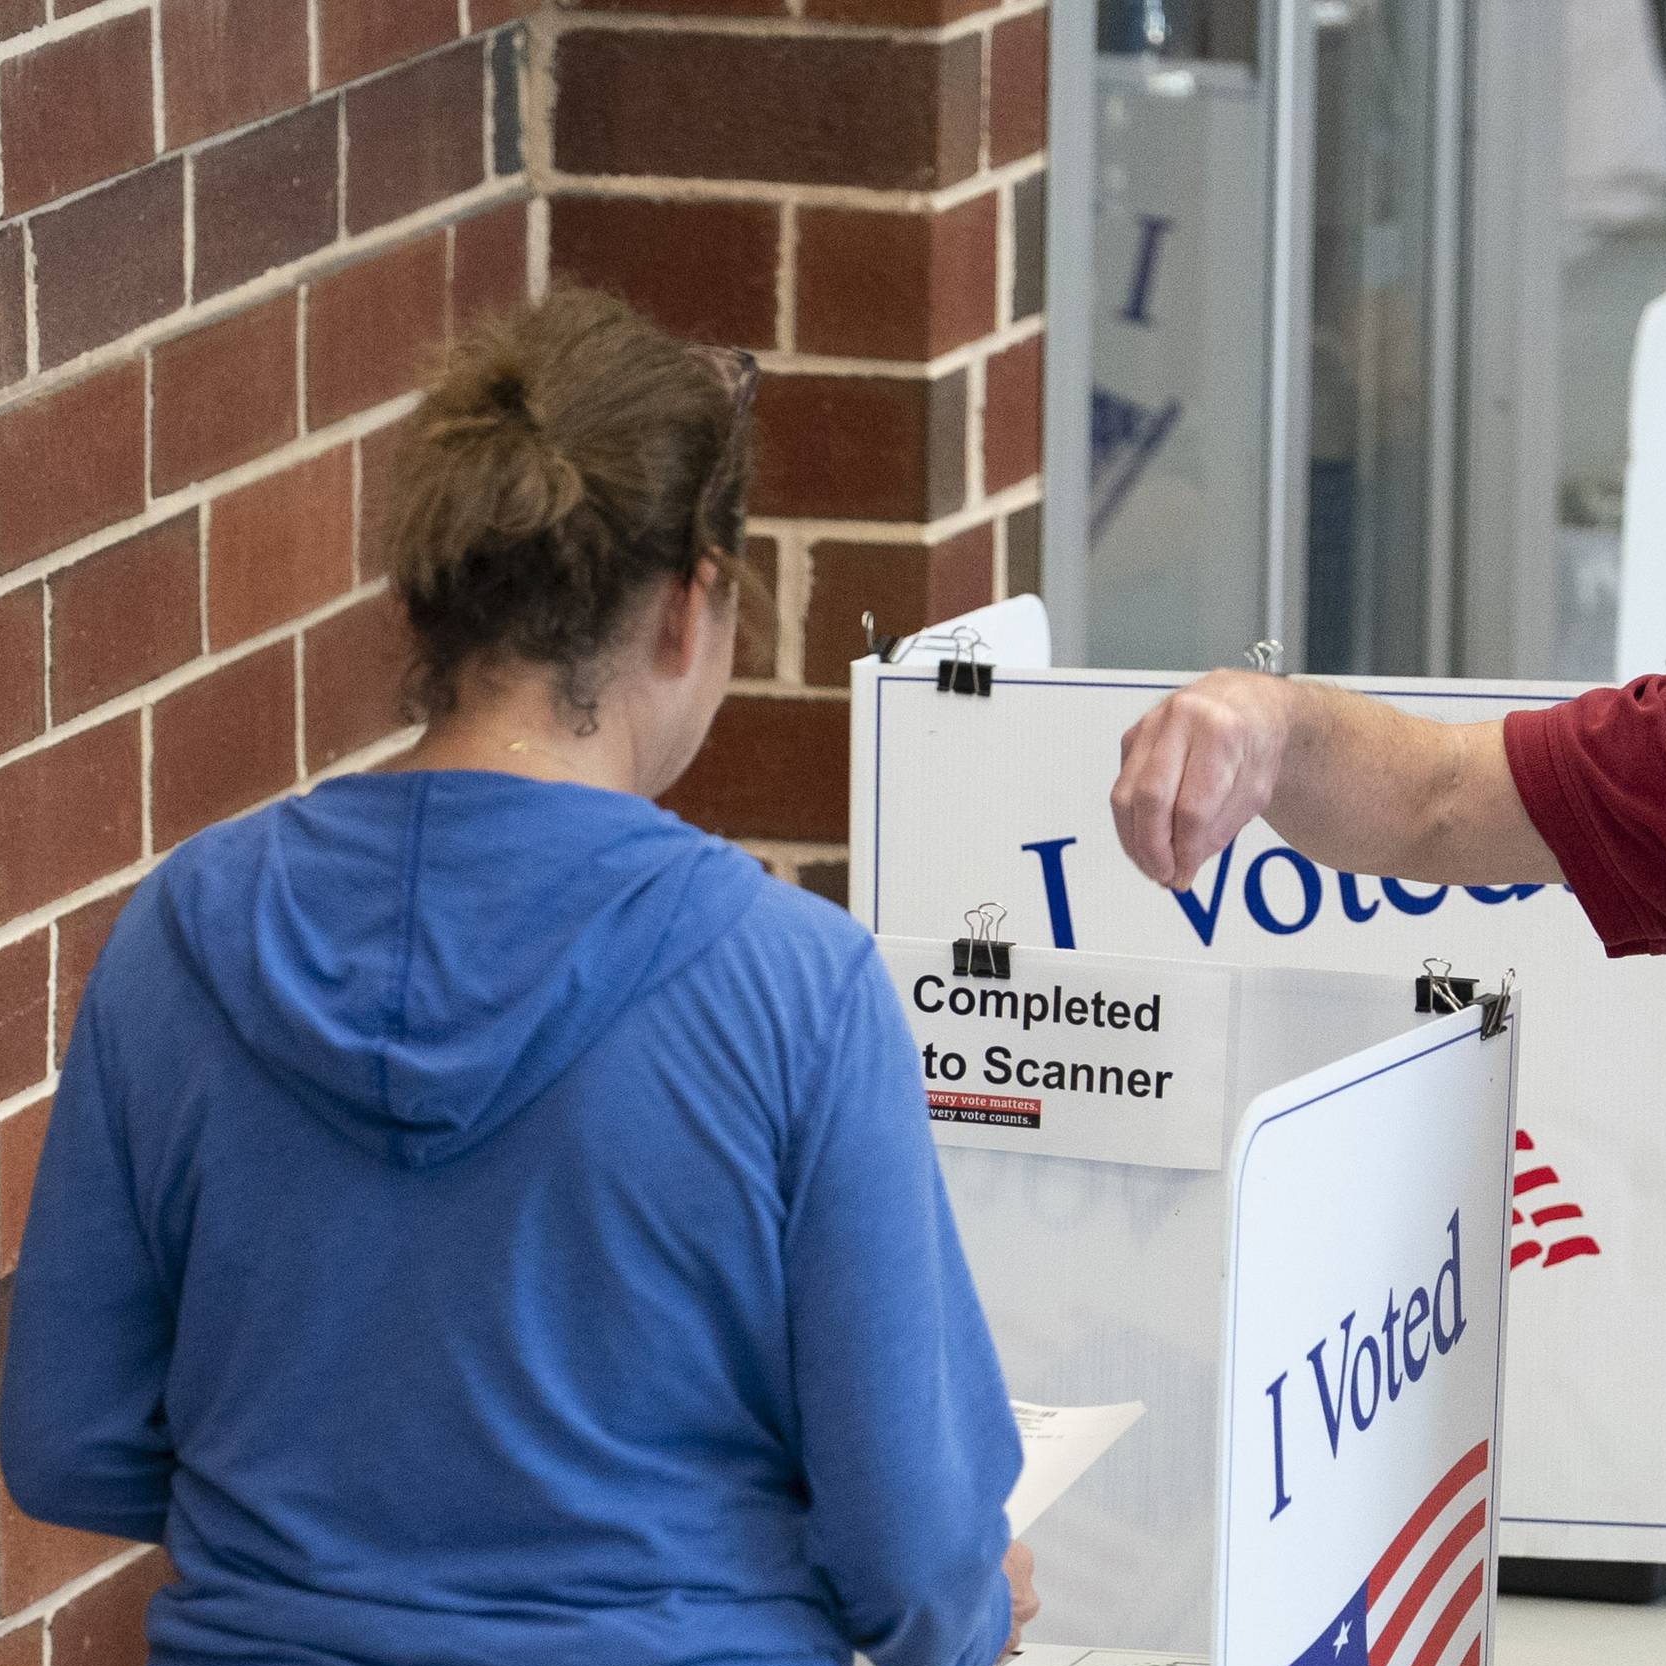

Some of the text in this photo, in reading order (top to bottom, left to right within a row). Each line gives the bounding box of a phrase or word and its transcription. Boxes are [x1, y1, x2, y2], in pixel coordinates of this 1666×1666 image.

[913, 974, 1161, 1032] Completed
[922, 1042, 1173, 1099] to Scanner
[928, 1108, 1032, 1126] very vote counts.
[961, 1095, 986, 1106] vote
[989, 1098, 1039, 1111] matters.
[1265, 1206, 1468, 1522] I Voted
